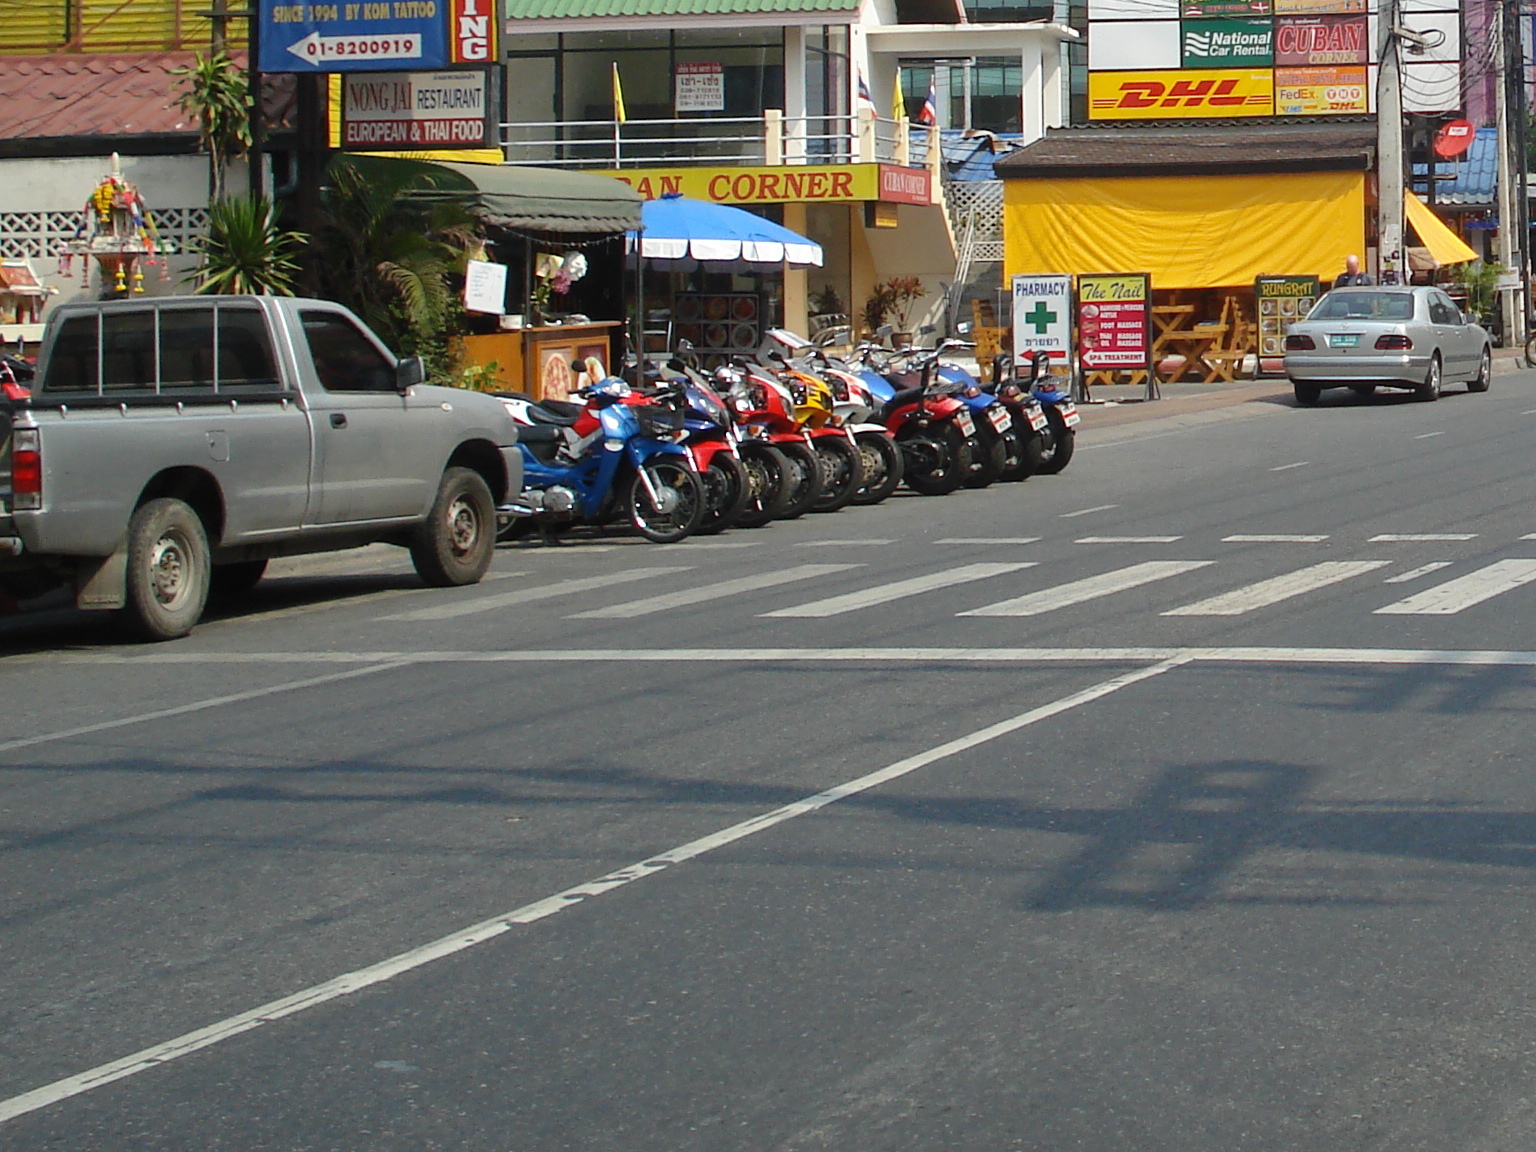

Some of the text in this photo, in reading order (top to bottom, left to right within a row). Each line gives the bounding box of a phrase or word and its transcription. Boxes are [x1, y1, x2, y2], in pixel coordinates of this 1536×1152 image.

[273, 2, 435, 23] SINCE 1994 BY KOM TATTOO
[1212, 31, 1271, 45] National
[1277, 23, 1363, 54] CUBAN
[307, 39, 413, 56] 01-8200919
[1210, 44, 1269, 56] Car Rental
[1308, 51, 1359, 64] CORNER
[350, 81, 482, 113] NONG JAI RESTAURANT
[1117, 79, 1248, 108] DHL
[1329, 102, 1358, 110] DHL
[347, 121, 484, 142] EUROPEAN & THAI FOOD
[708, 172, 854, 201] CORNER
[884, 171, 925, 195] CUBAN CORNER
[1016, 282, 1066, 296] PHARMACY
[1081, 282, 1142, 300] The Nail
[1261, 282, 1314, 297] RUNGRAT
